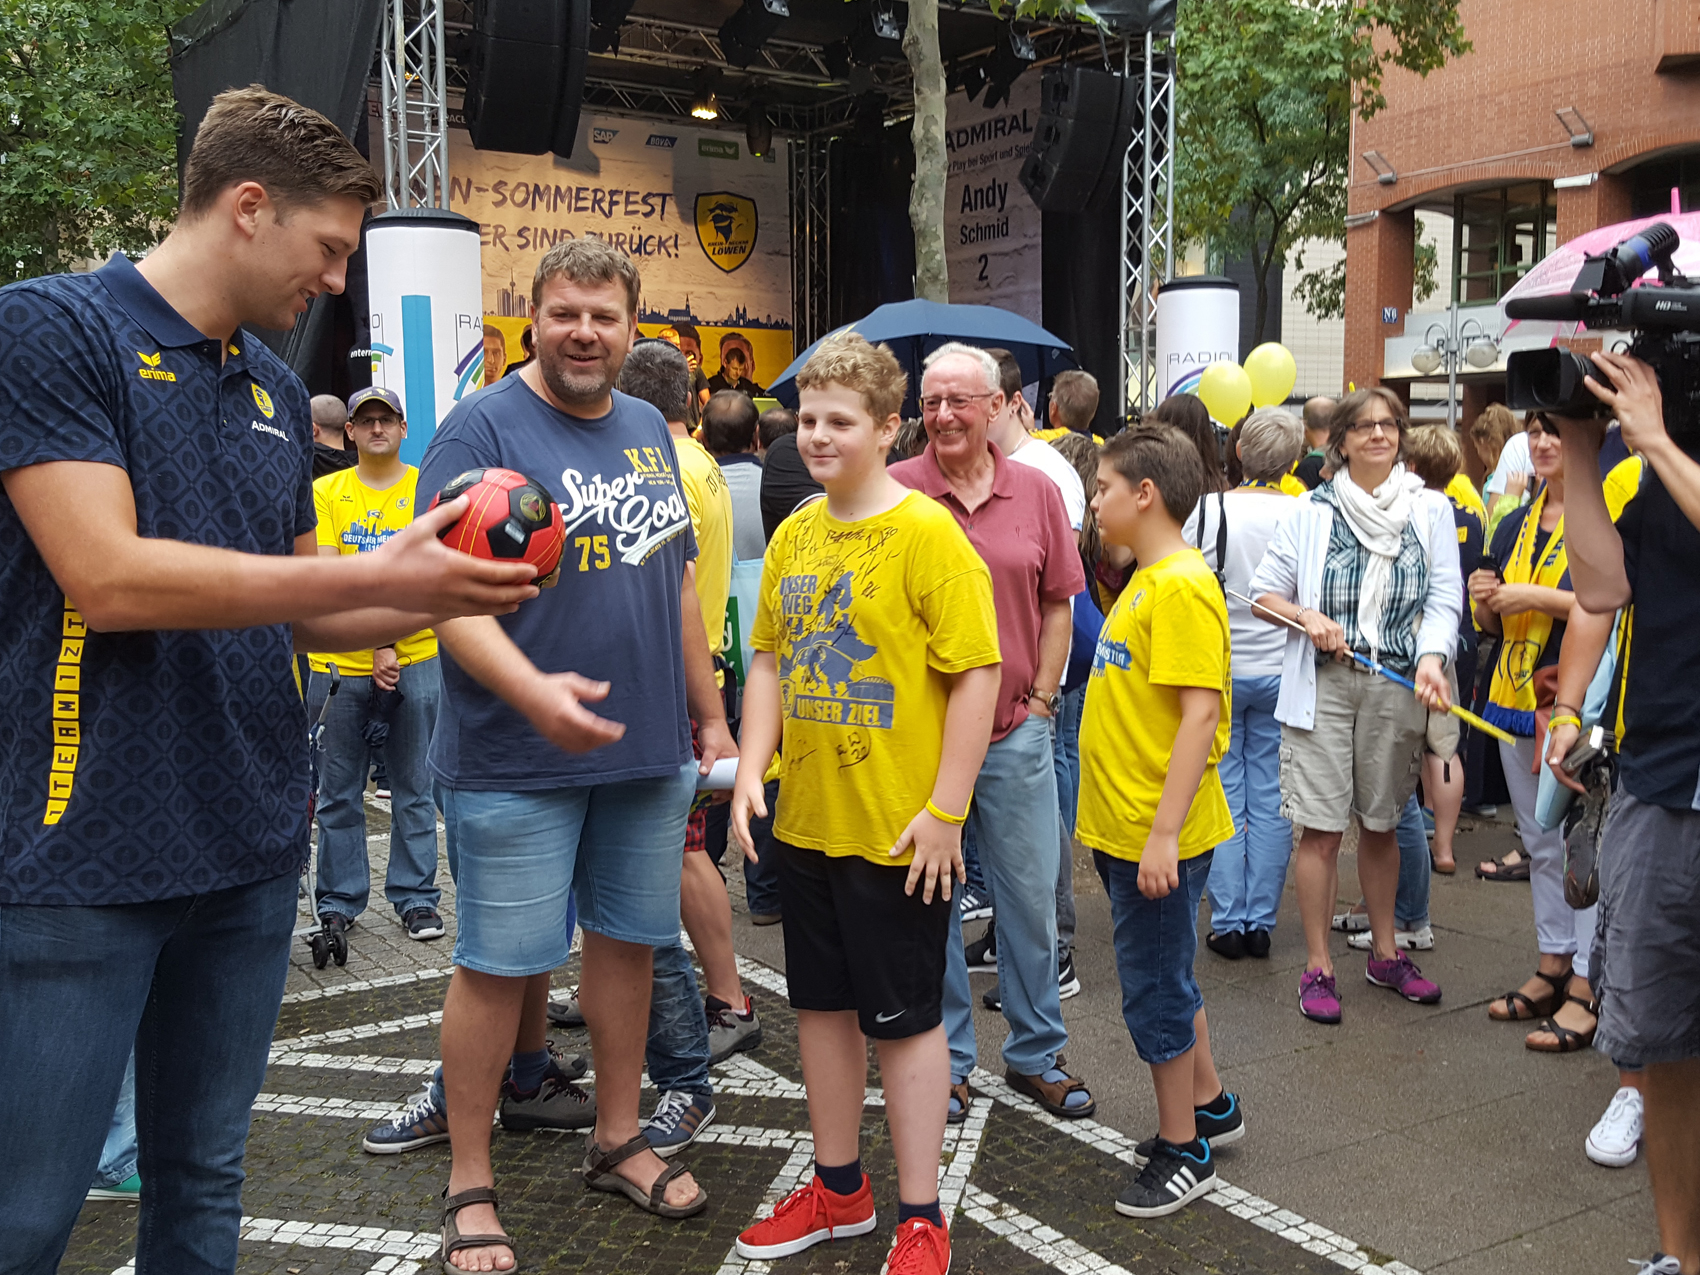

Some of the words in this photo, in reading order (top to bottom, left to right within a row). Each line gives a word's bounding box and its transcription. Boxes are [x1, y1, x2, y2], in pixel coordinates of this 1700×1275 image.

[594, 130, 614, 142] SAP
[945, 108, 1033, 152] ADMIRAL
[961, 177, 1008, 214] Andy
[960, 216, 1009, 245] Schmid
[978, 253, 989, 281] 2
[139, 367, 177, 382] erima
[252, 420, 289, 442] ADMIRAL
[557, 468, 645, 525] Super
[574, 534, 612, 572] 75
[796, 697, 843, 723] UNSER
[846, 702, 881, 726] ZIEL
